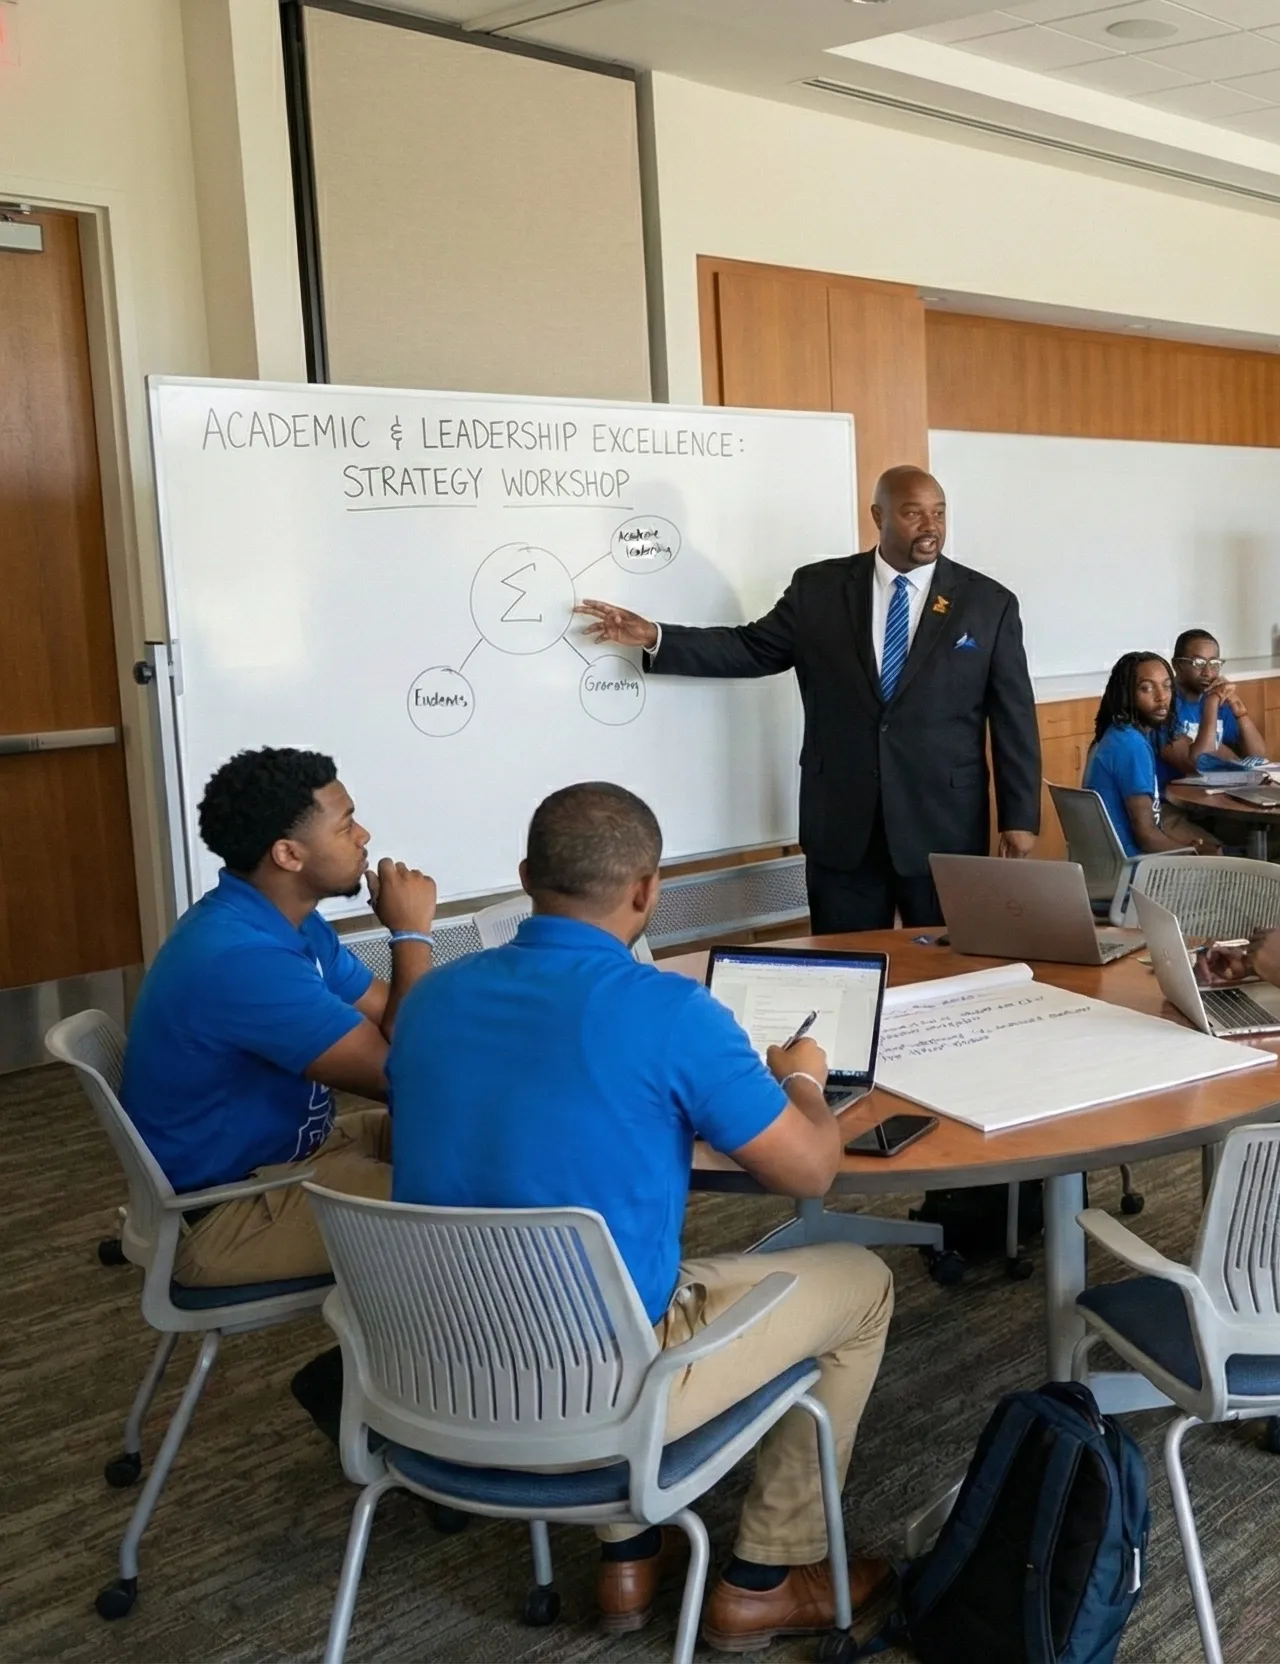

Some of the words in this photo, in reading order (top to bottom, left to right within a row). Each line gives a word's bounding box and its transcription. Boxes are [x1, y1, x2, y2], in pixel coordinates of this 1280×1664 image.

[202, 406, 371, 451] ACADEMIC
[390, 414, 403, 451] &
[421, 416, 578, 452] LEADERSHIP
[592, 423, 745, 457] EXCELLENCE:
[342, 464, 486, 499] STRATEGY
[500, 467, 631, 499] WORKSHOP
